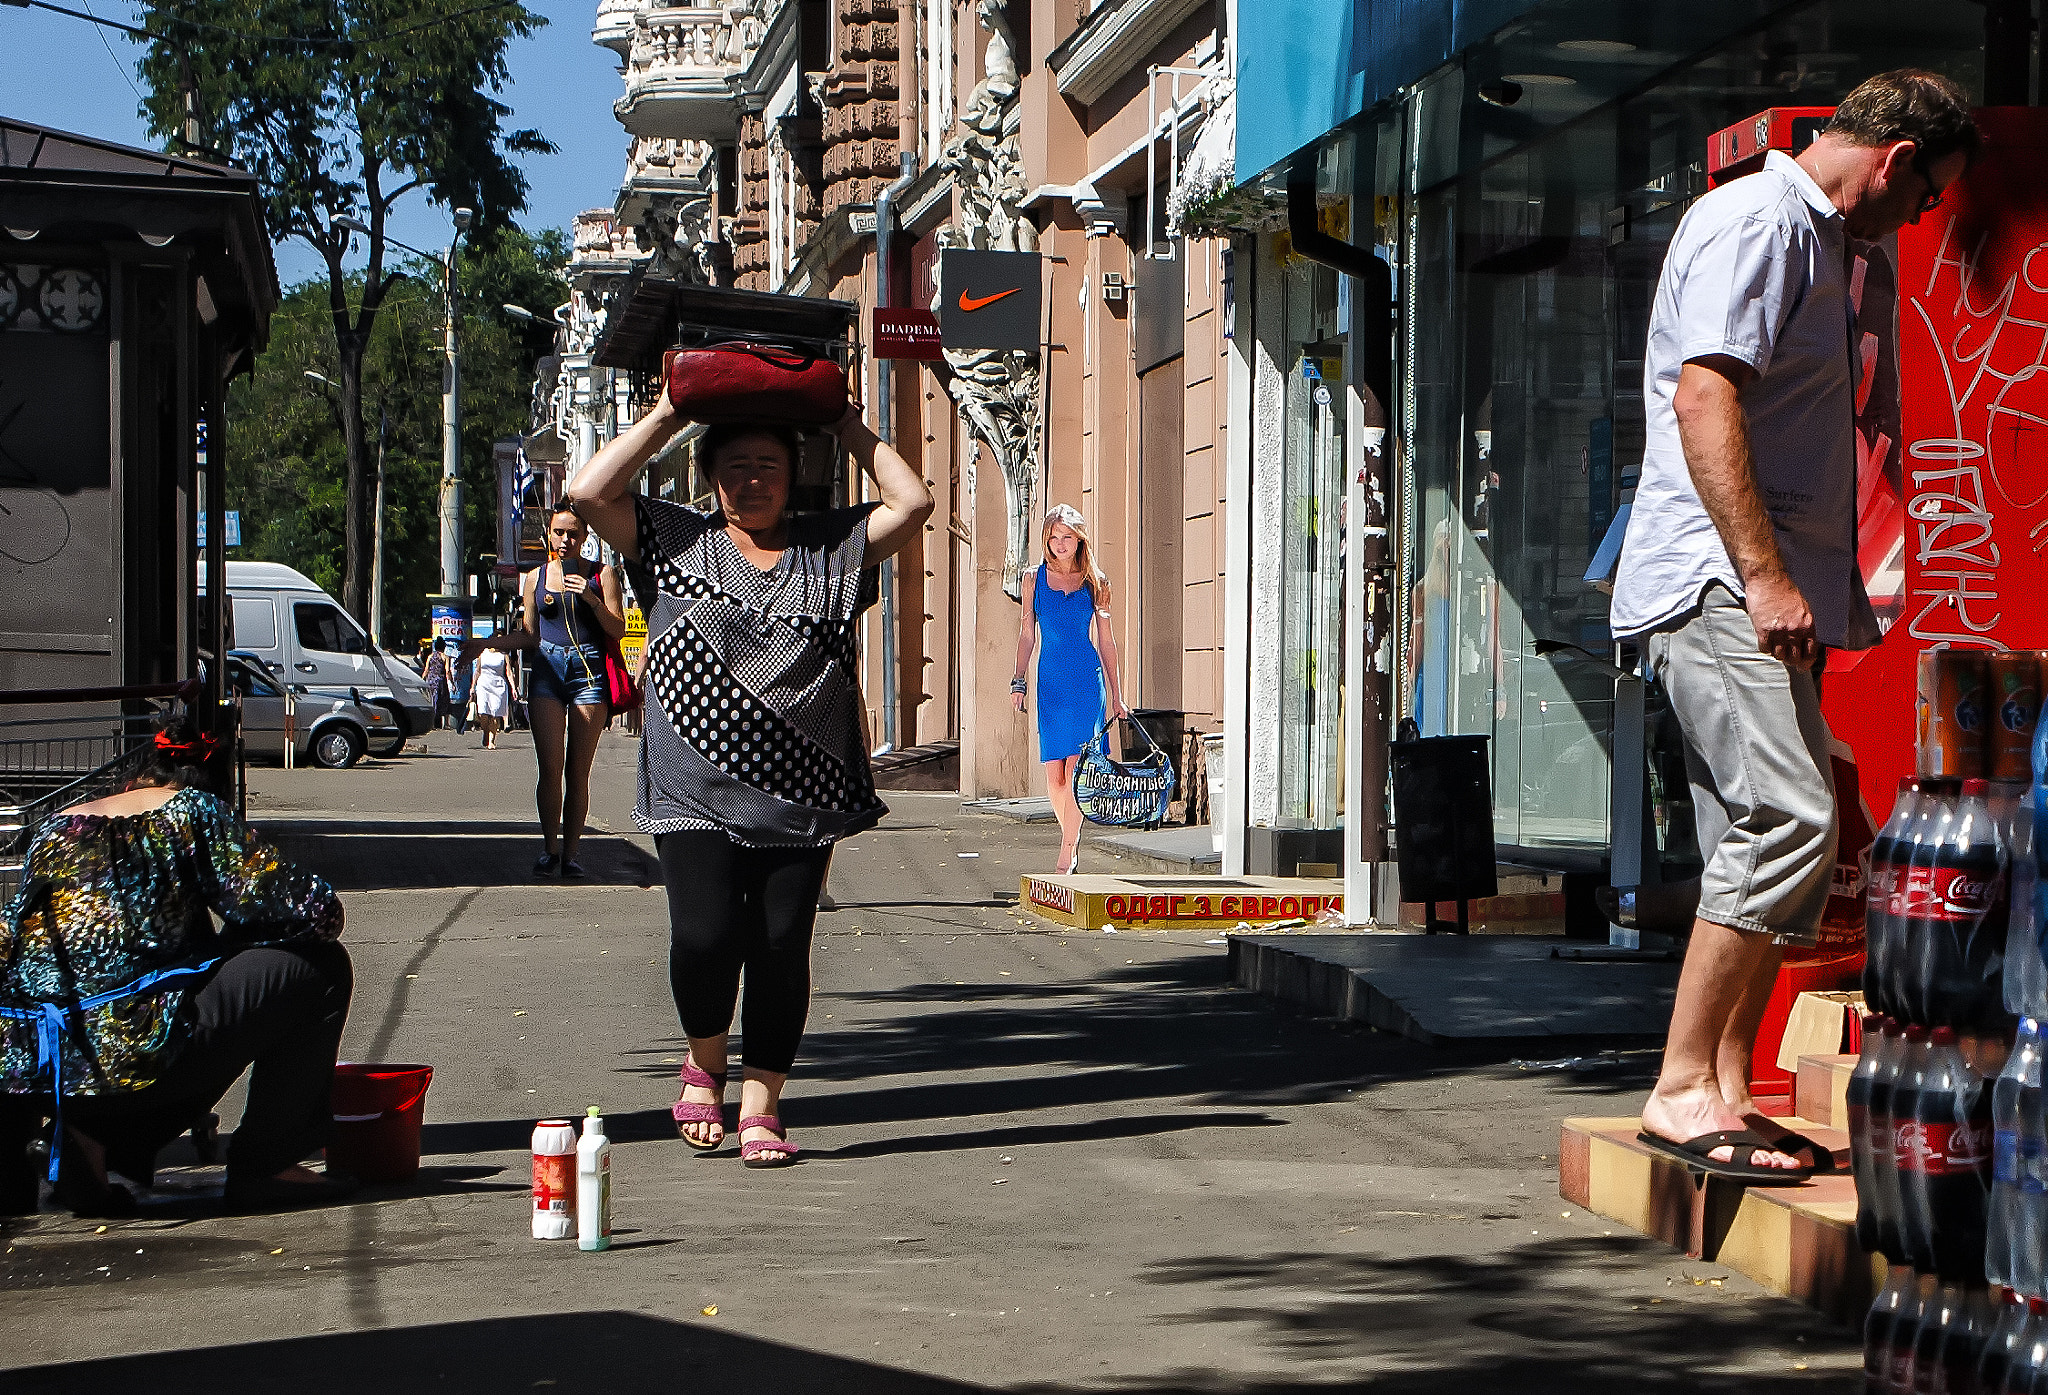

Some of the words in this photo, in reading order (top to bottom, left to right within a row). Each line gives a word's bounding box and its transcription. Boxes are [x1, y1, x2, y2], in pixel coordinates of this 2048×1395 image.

[881, 323, 942, 335] DIADEMA
[1105, 894, 1187, 924] ОДЯГ
[1193, 894, 1212, 917] З
[1220, 894, 1344, 918] ЄВРОПИ
